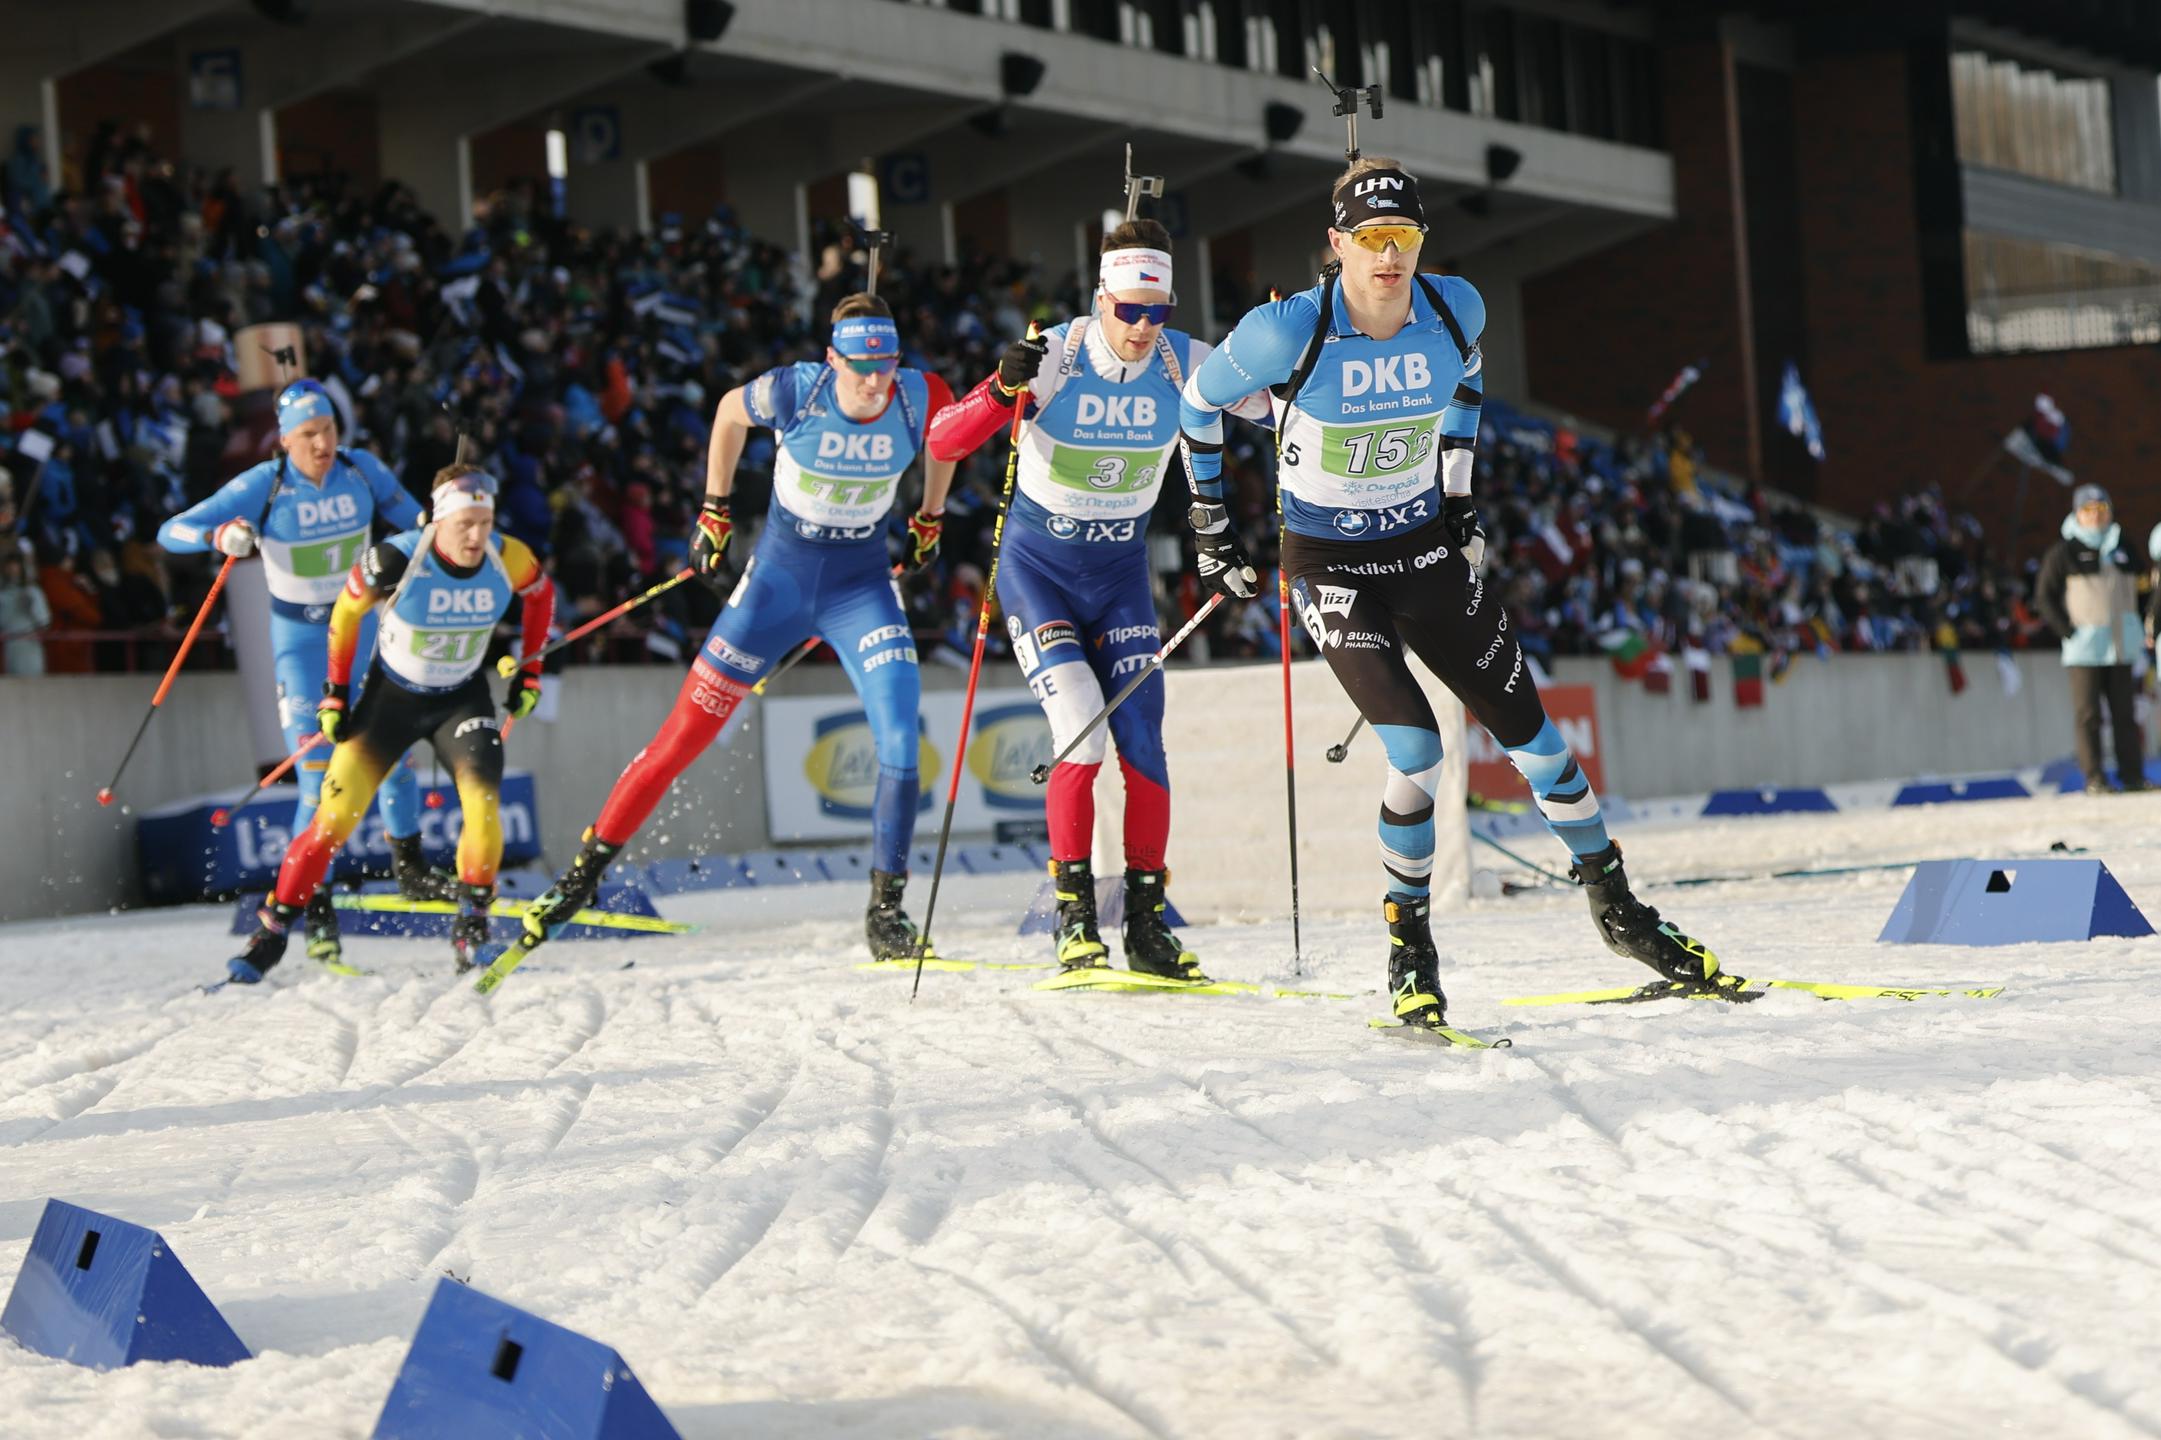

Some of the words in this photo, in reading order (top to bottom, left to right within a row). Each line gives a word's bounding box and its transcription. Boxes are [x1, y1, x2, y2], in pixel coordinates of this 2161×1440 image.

[1059, 323, 1085, 375] OCUTEIN
[1156, 332, 1181, 382] CUTEIN
[1342, 353, 1432, 397] DKB
[1075, 394, 1157, 427] DKB
[1342, 402, 1366, 415] Das
[1369, 400, 1400, 412] kann
[1402, 392, 1434, 407] Bank
[817, 431, 894, 461] DKB
[1073, 428, 1095, 440] Das
[1097, 429, 1124, 440] kann
[1126, 431, 1154, 441] Bank
[814, 459, 835, 471] Das
[837, 462, 862, 472] kann
[865, 463, 891, 473] Bank
[1088, 456, 1127, 489] 3
[297, 494, 358, 528] DKB
[1086, 519, 1136, 542] iX3
[1327, 559, 1405, 576] etilevi
[1415, 547, 1447, 568] PLG
[428, 588, 495, 614] DKB
[1324, 592, 1352, 605] iizi
[858, 625, 914, 653] ATEX
[1345, 641, 1380, 651] PHARMA
[1346, 630, 1391, 649] auxilia
[1476, 634, 1505, 670] Sony
[1017, 645, 1028, 670] 3
